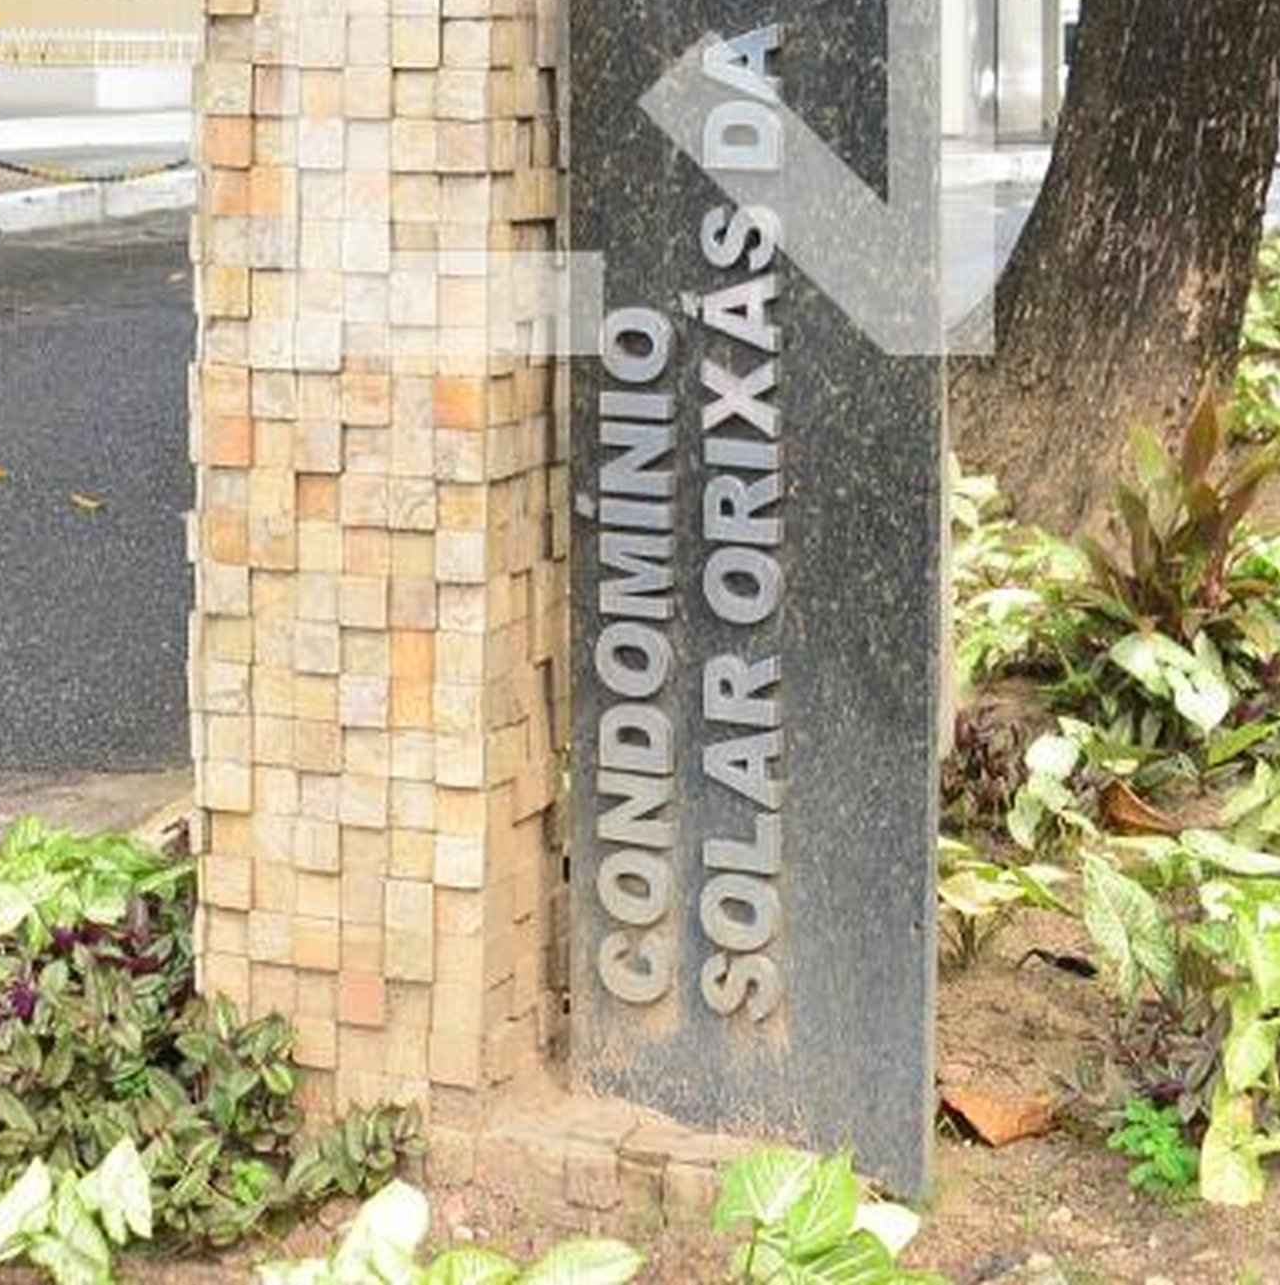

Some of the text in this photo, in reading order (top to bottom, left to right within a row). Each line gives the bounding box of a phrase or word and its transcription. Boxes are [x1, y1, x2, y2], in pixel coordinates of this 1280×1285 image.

[700, 22, 783, 172] DA
[677, 203, 783, 625] ORIXÁS
[577, 306, 676, 1005] CONDOMÍNIO
[699, 655, 784, 1024] SOLAR
